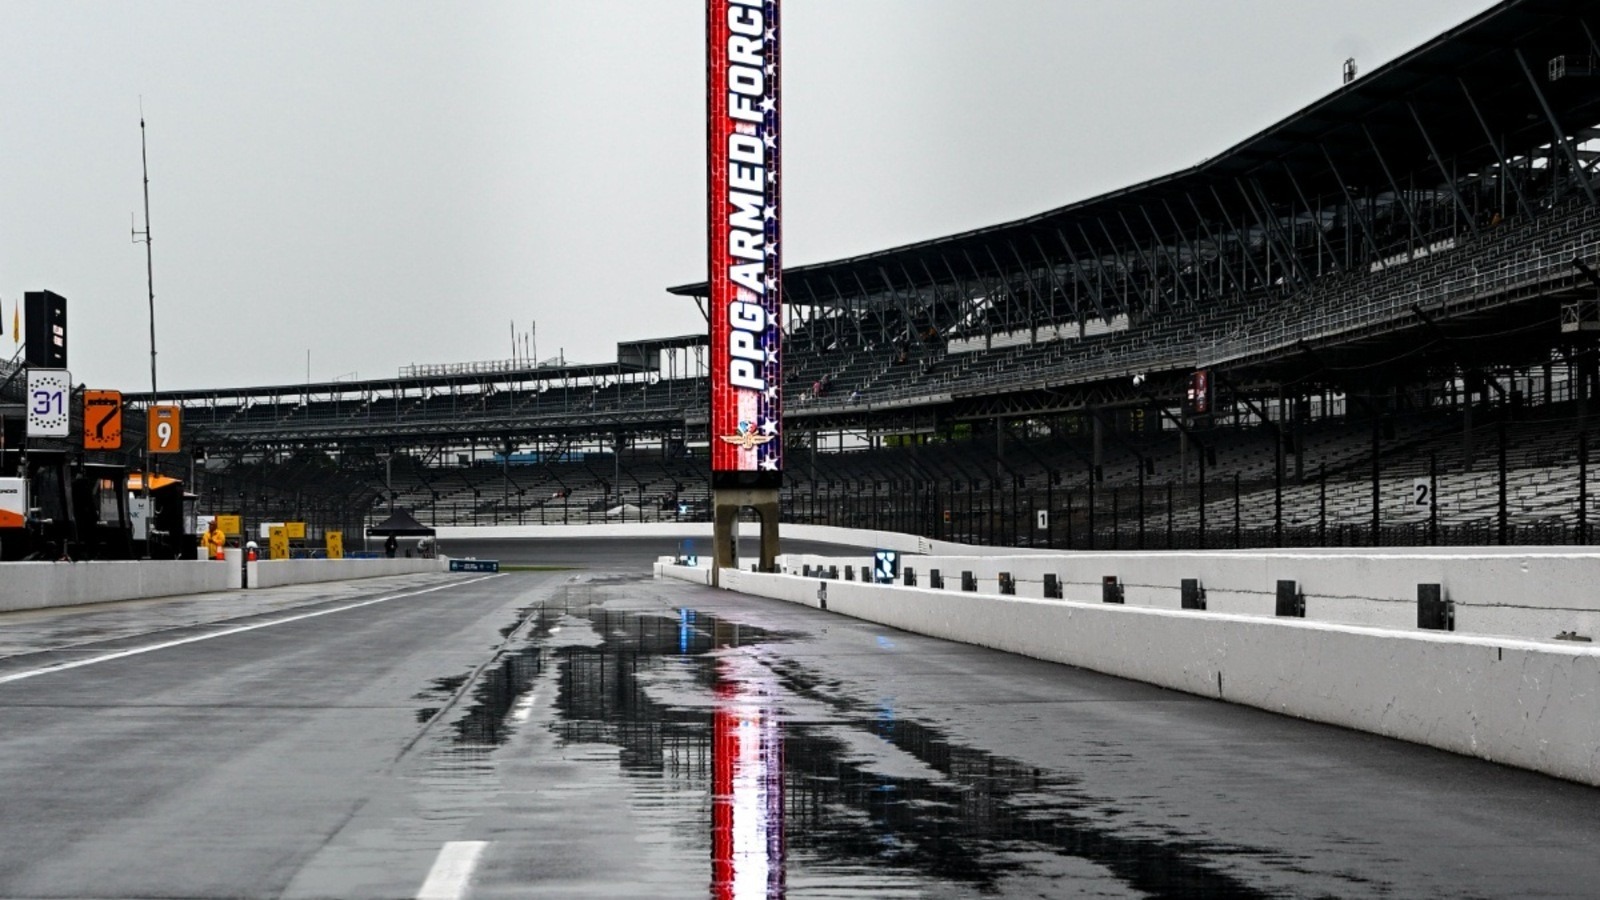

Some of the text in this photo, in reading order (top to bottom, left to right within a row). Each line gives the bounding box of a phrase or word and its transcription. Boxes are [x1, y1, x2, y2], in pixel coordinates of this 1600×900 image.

[728, 0, 765, 390] PPG ARMED FORC
[33, 391, 62, 415] 31
[87, 399, 119, 439] 7
[157, 422, 172, 448] 9
[1415, 484, 1428, 506] 2
[1039, 513, 1046, 526] 1
